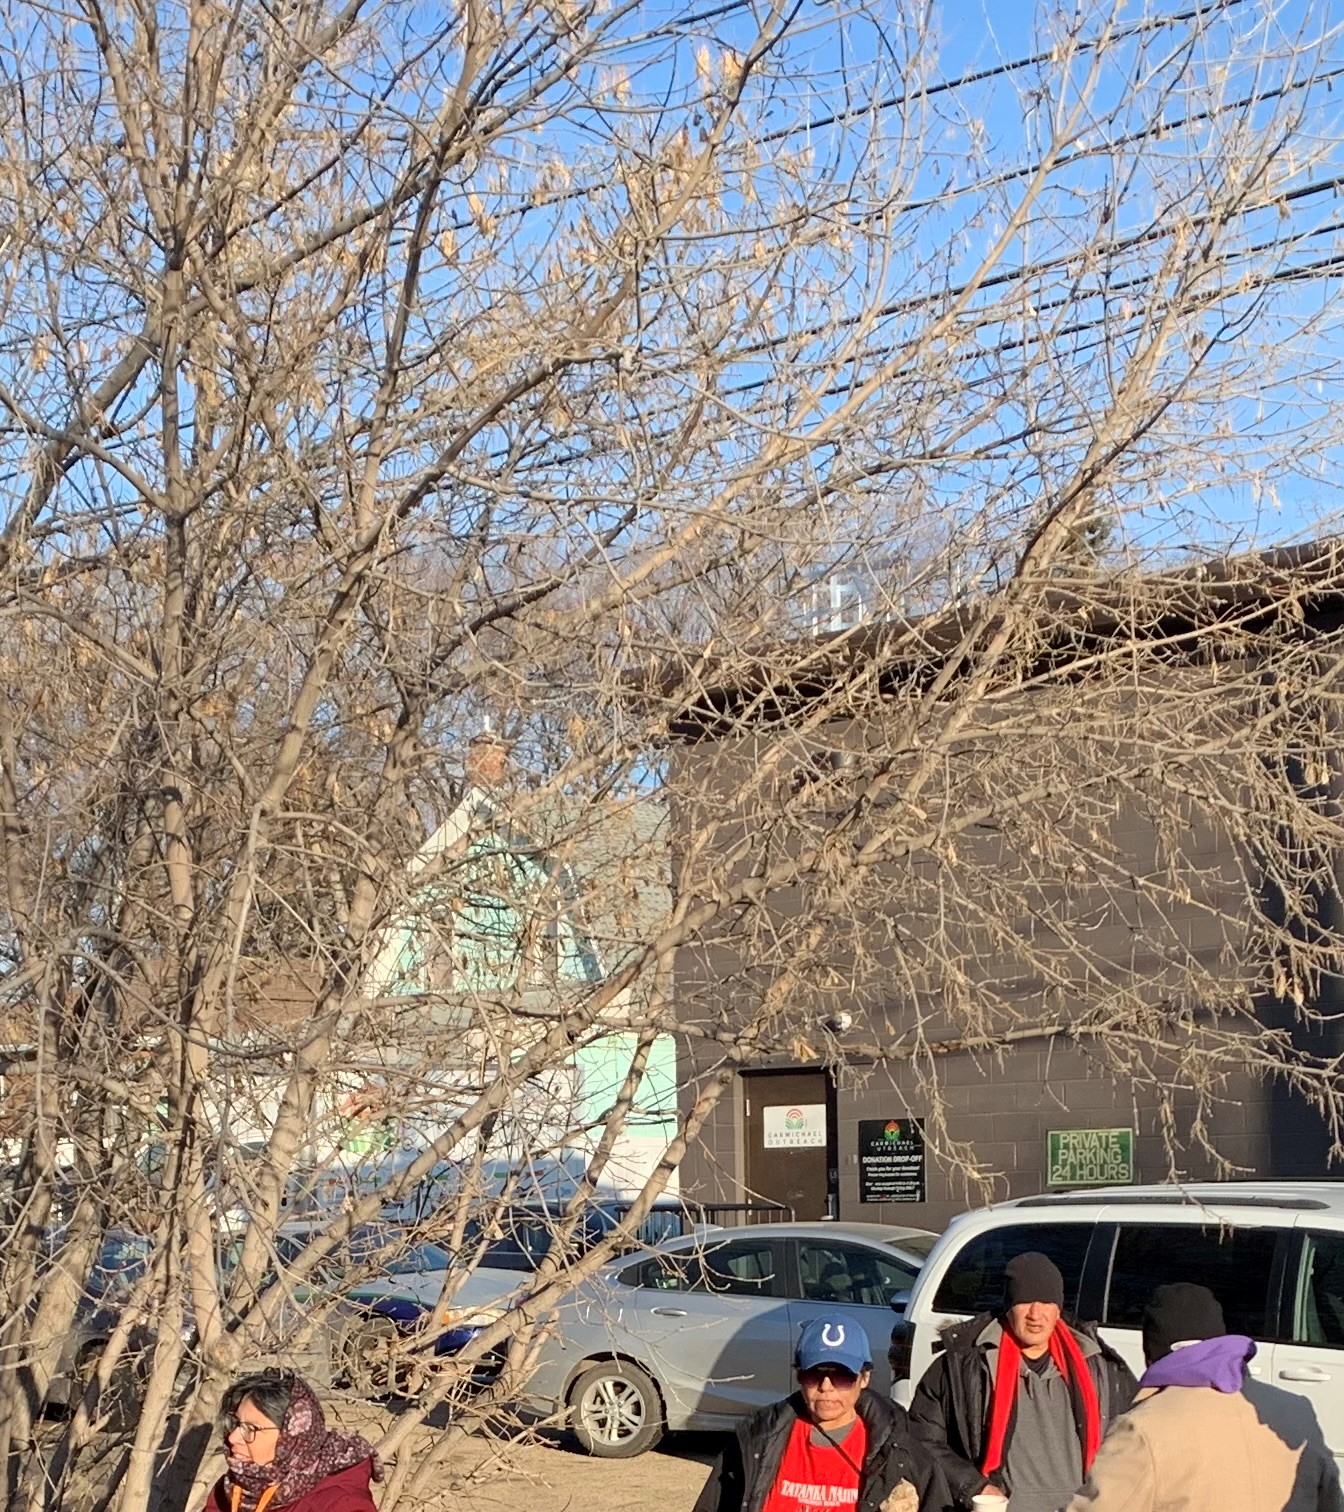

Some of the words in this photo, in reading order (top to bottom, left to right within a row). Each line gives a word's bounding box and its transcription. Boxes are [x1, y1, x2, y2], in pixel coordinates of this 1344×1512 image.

[1059, 1131, 1121, 1149] PRIVATE
[862, 1156, 892, 1164] DONATION
[1058, 1148, 1122, 1165] PARKING
[1052, 1165, 1072, 1181] 24
[1076, 1163, 1129, 1181] HOURS
[781, 1479, 827, 1501] TATANKA
